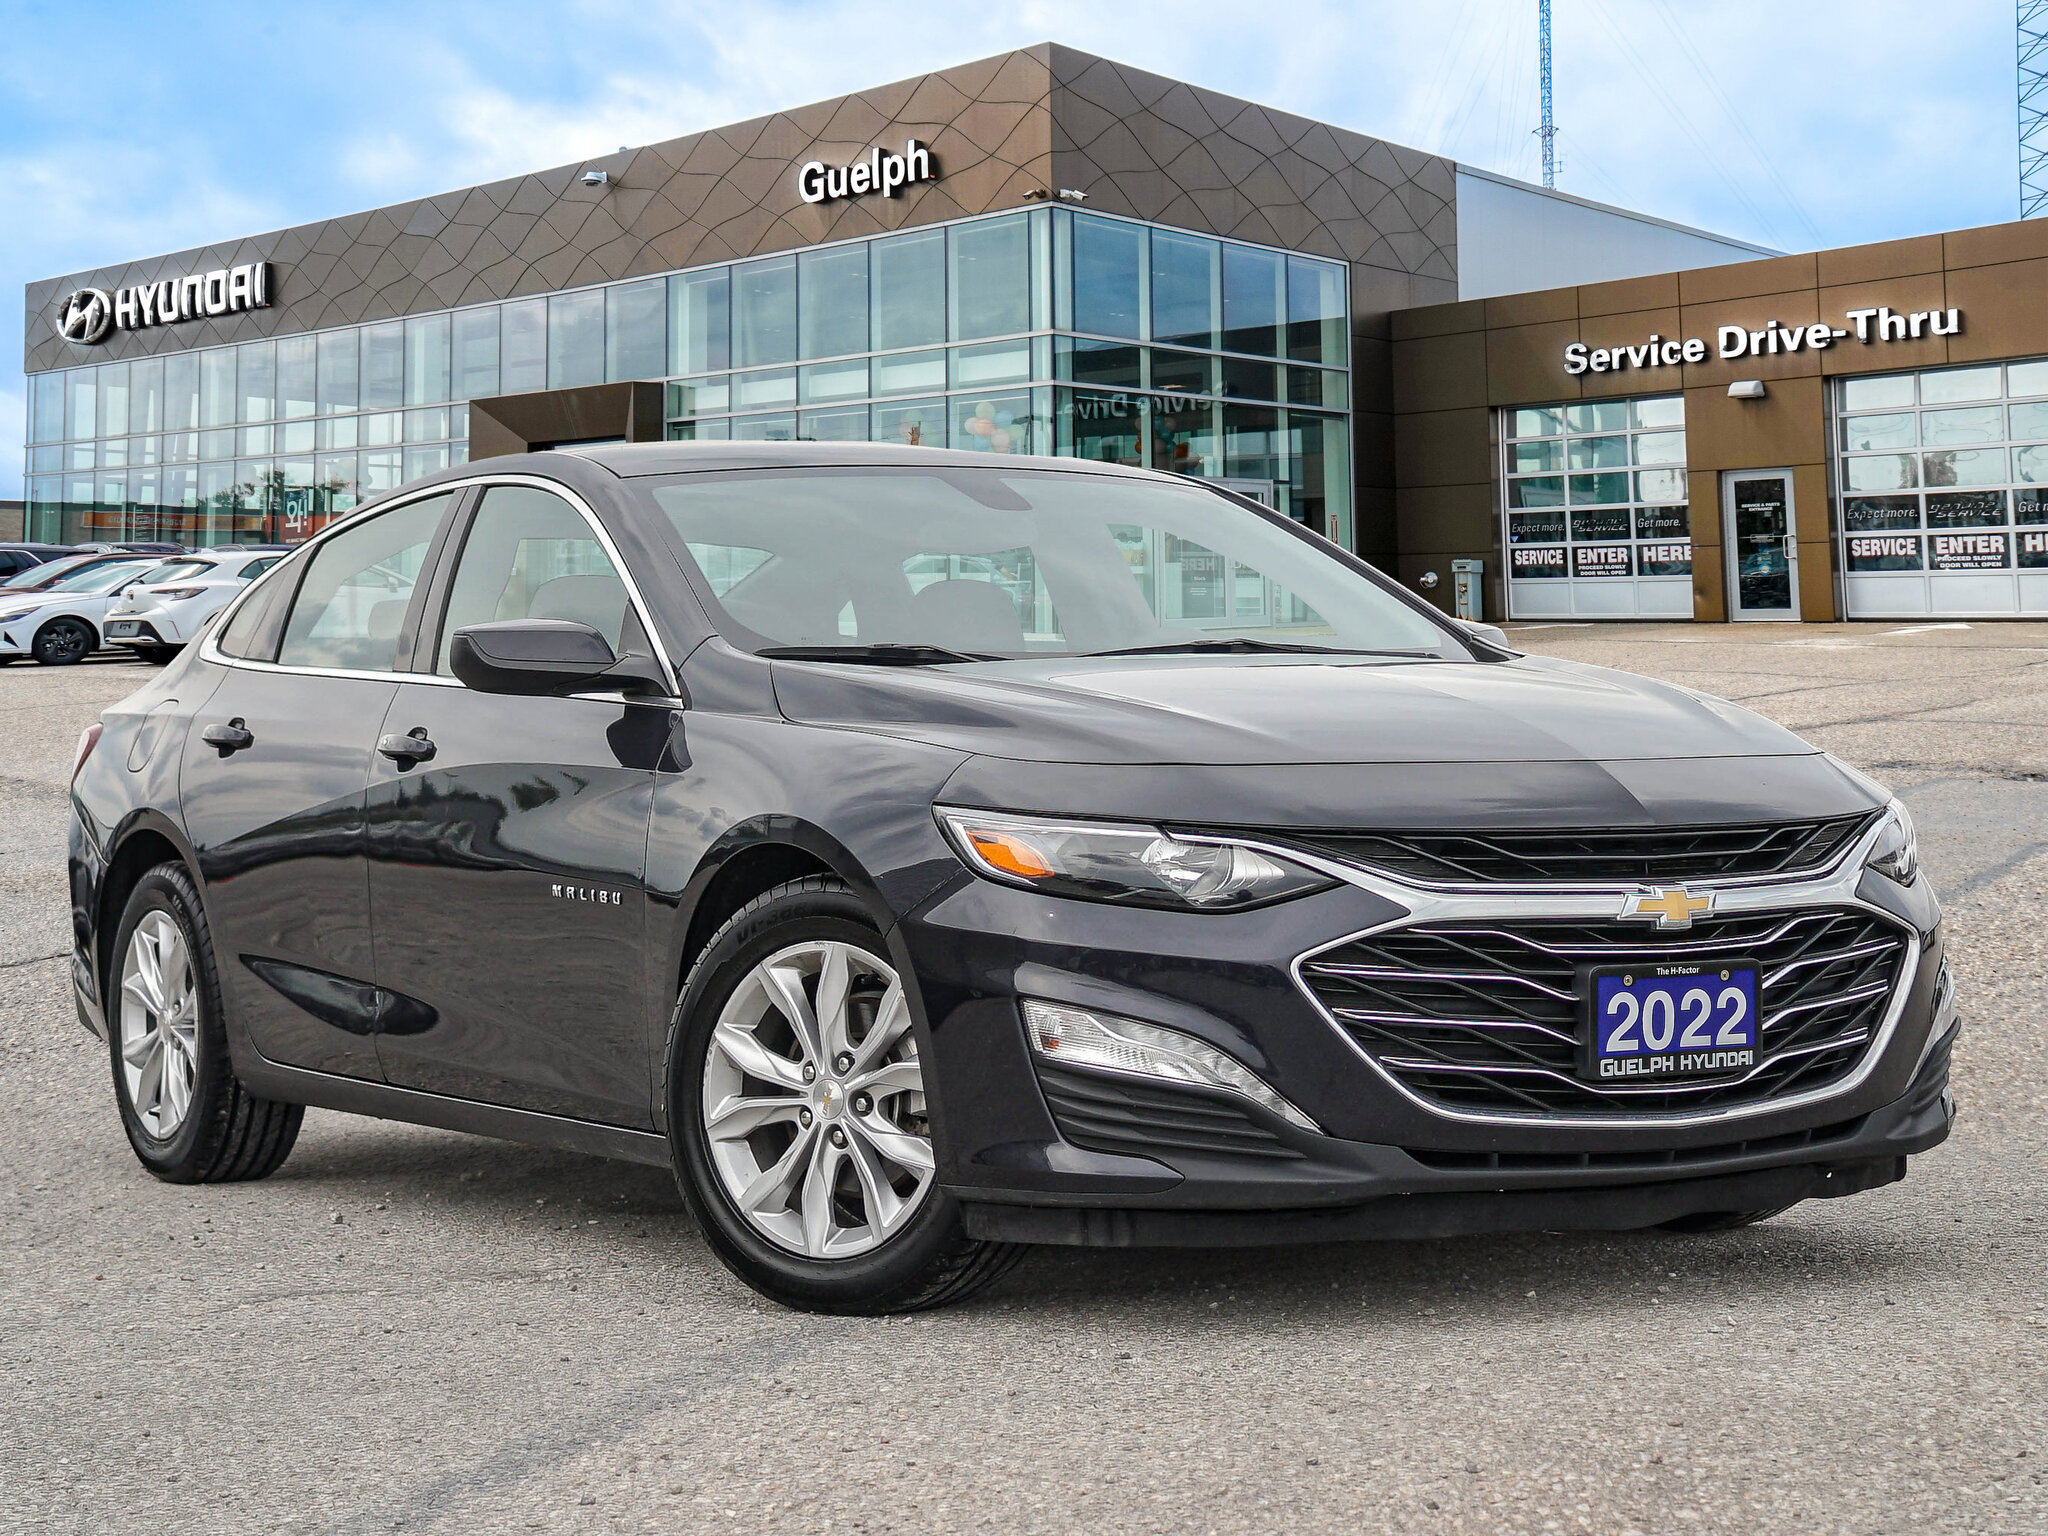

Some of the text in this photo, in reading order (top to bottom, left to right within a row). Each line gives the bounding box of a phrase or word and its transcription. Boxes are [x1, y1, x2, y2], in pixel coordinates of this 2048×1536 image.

[799, 139, 929, 203] Guelph
[115, 262, 269, 330] HYUNDAI
[1563, 306, 1962, 375] Service Drive-Thru
[1847, 508, 1919, 521] Expect more.
[1936, 508, 2002, 518] SERVICE
[2018, 501, 2040, 513] Get
[1512, 523, 1565, 534] Expect more.
[1637, 517, 1681, 528] Get more.
[1851, 537, 1917, 557] SERVICE
[1935, 535, 2005, 554] ENTER
[1514, 549, 1564, 566] SERVICE
[1577, 547, 1629, 565] ENTER
[1642, 545, 1692, 563] HERE
[552, 884, 621, 905] MALIBU
[1656, 966, 1700, 976] The H-Factor
[1606, 987, 1748, 1053] 2022
[1600, 1050, 1754, 1077] GUELPH HYUNDAI
